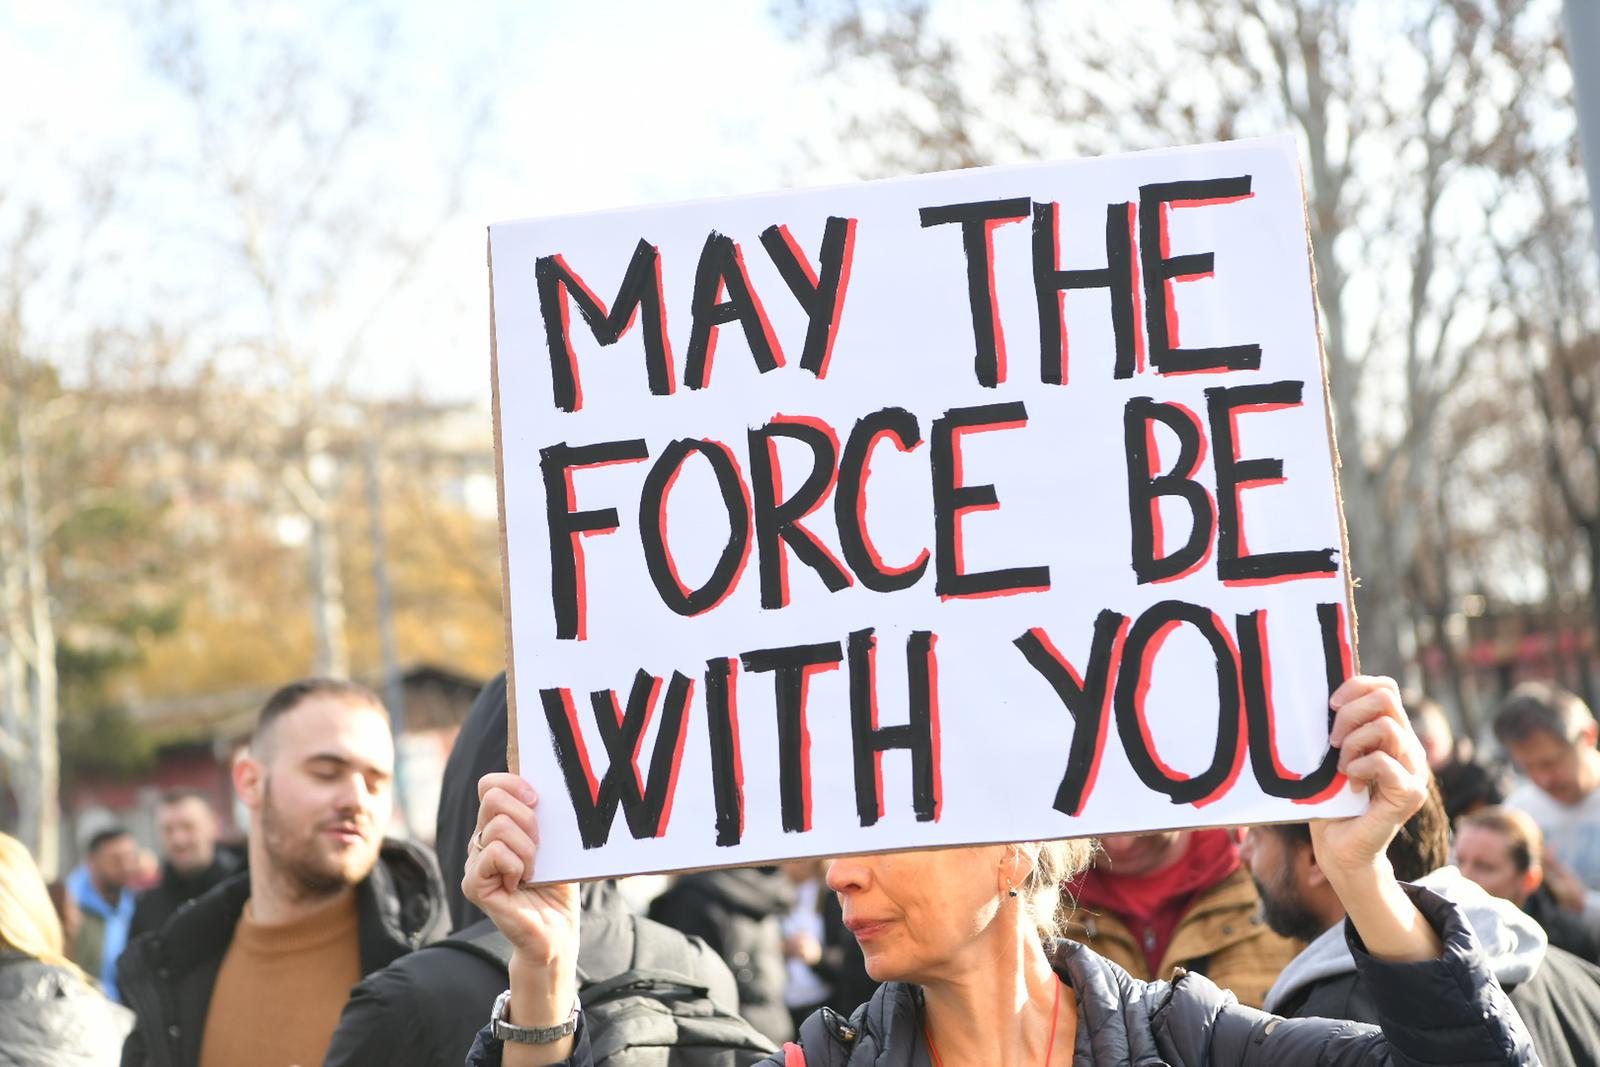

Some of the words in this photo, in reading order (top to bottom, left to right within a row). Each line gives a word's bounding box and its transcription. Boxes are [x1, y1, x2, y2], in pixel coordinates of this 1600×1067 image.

[535, 216, 857, 412] MAY
[920, 175, 1262, 388] THE
[538, 402, 1051, 641] FORCE
[1124, 381, 1340, 587] BE
[538, 627, 942, 849] WITH
[1013, 600, 1353, 817] YOU
